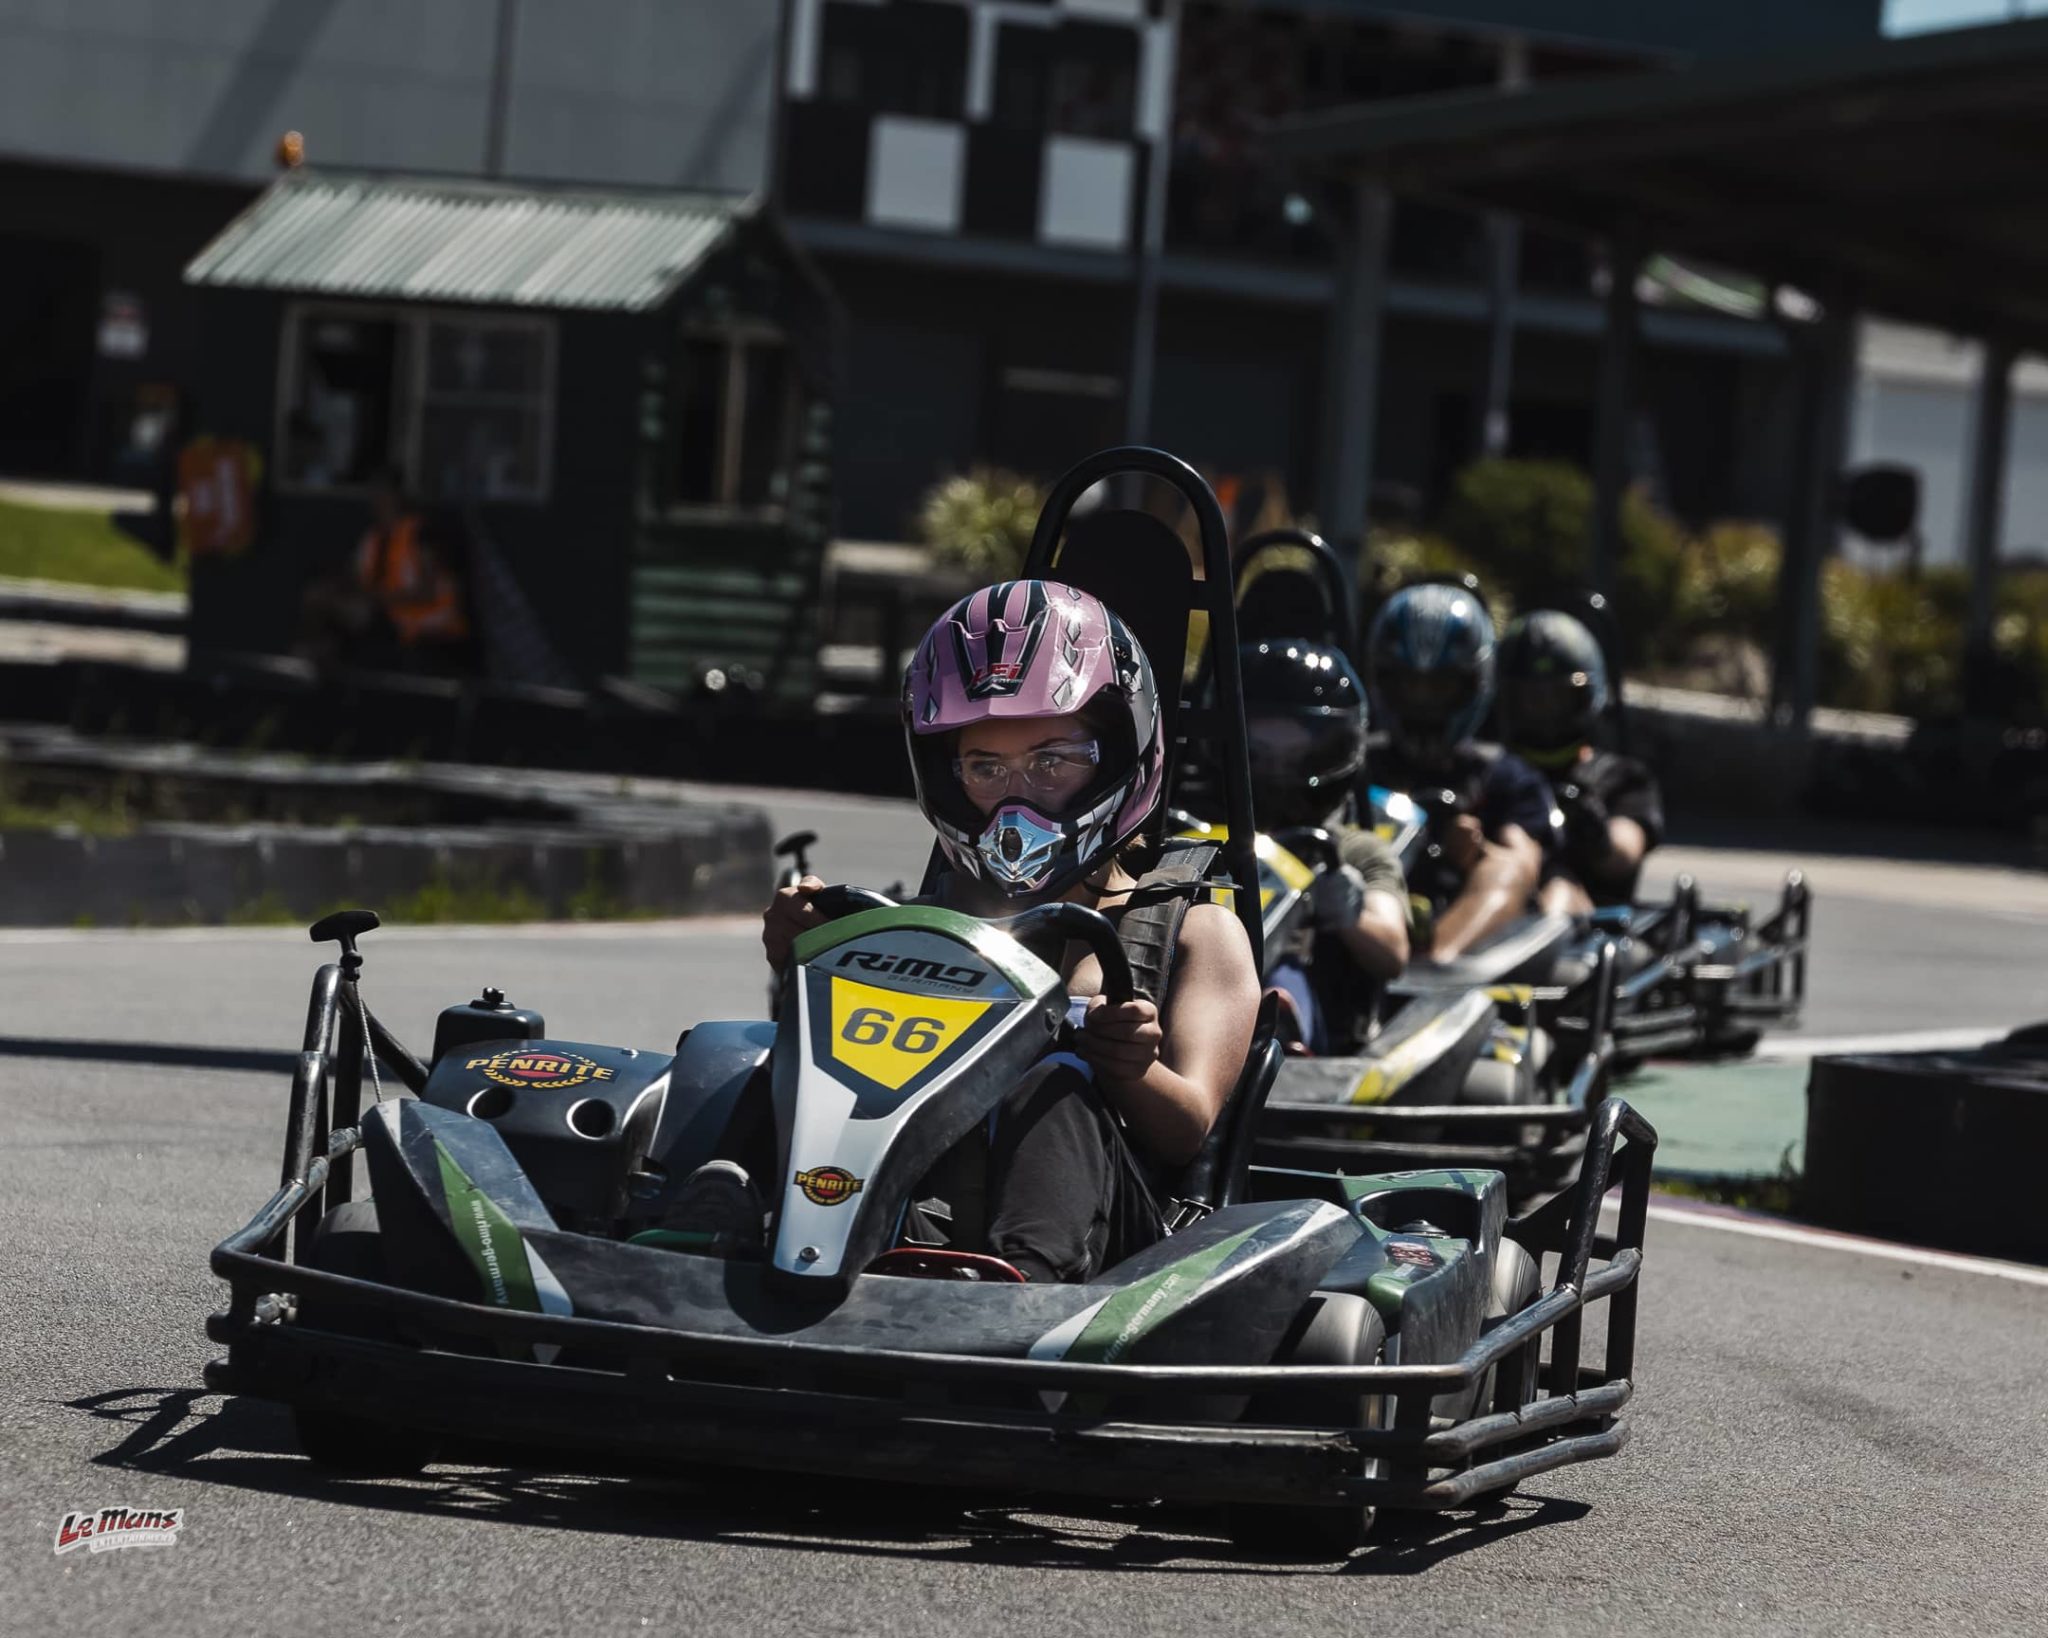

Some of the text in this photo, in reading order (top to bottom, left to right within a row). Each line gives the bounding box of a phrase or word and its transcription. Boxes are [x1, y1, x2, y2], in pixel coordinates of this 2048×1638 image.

[841, 1007, 946, 1054] 66
[465, 1058, 615, 1080] PENRITE
[797, 1173, 861, 1191] PENRITE
